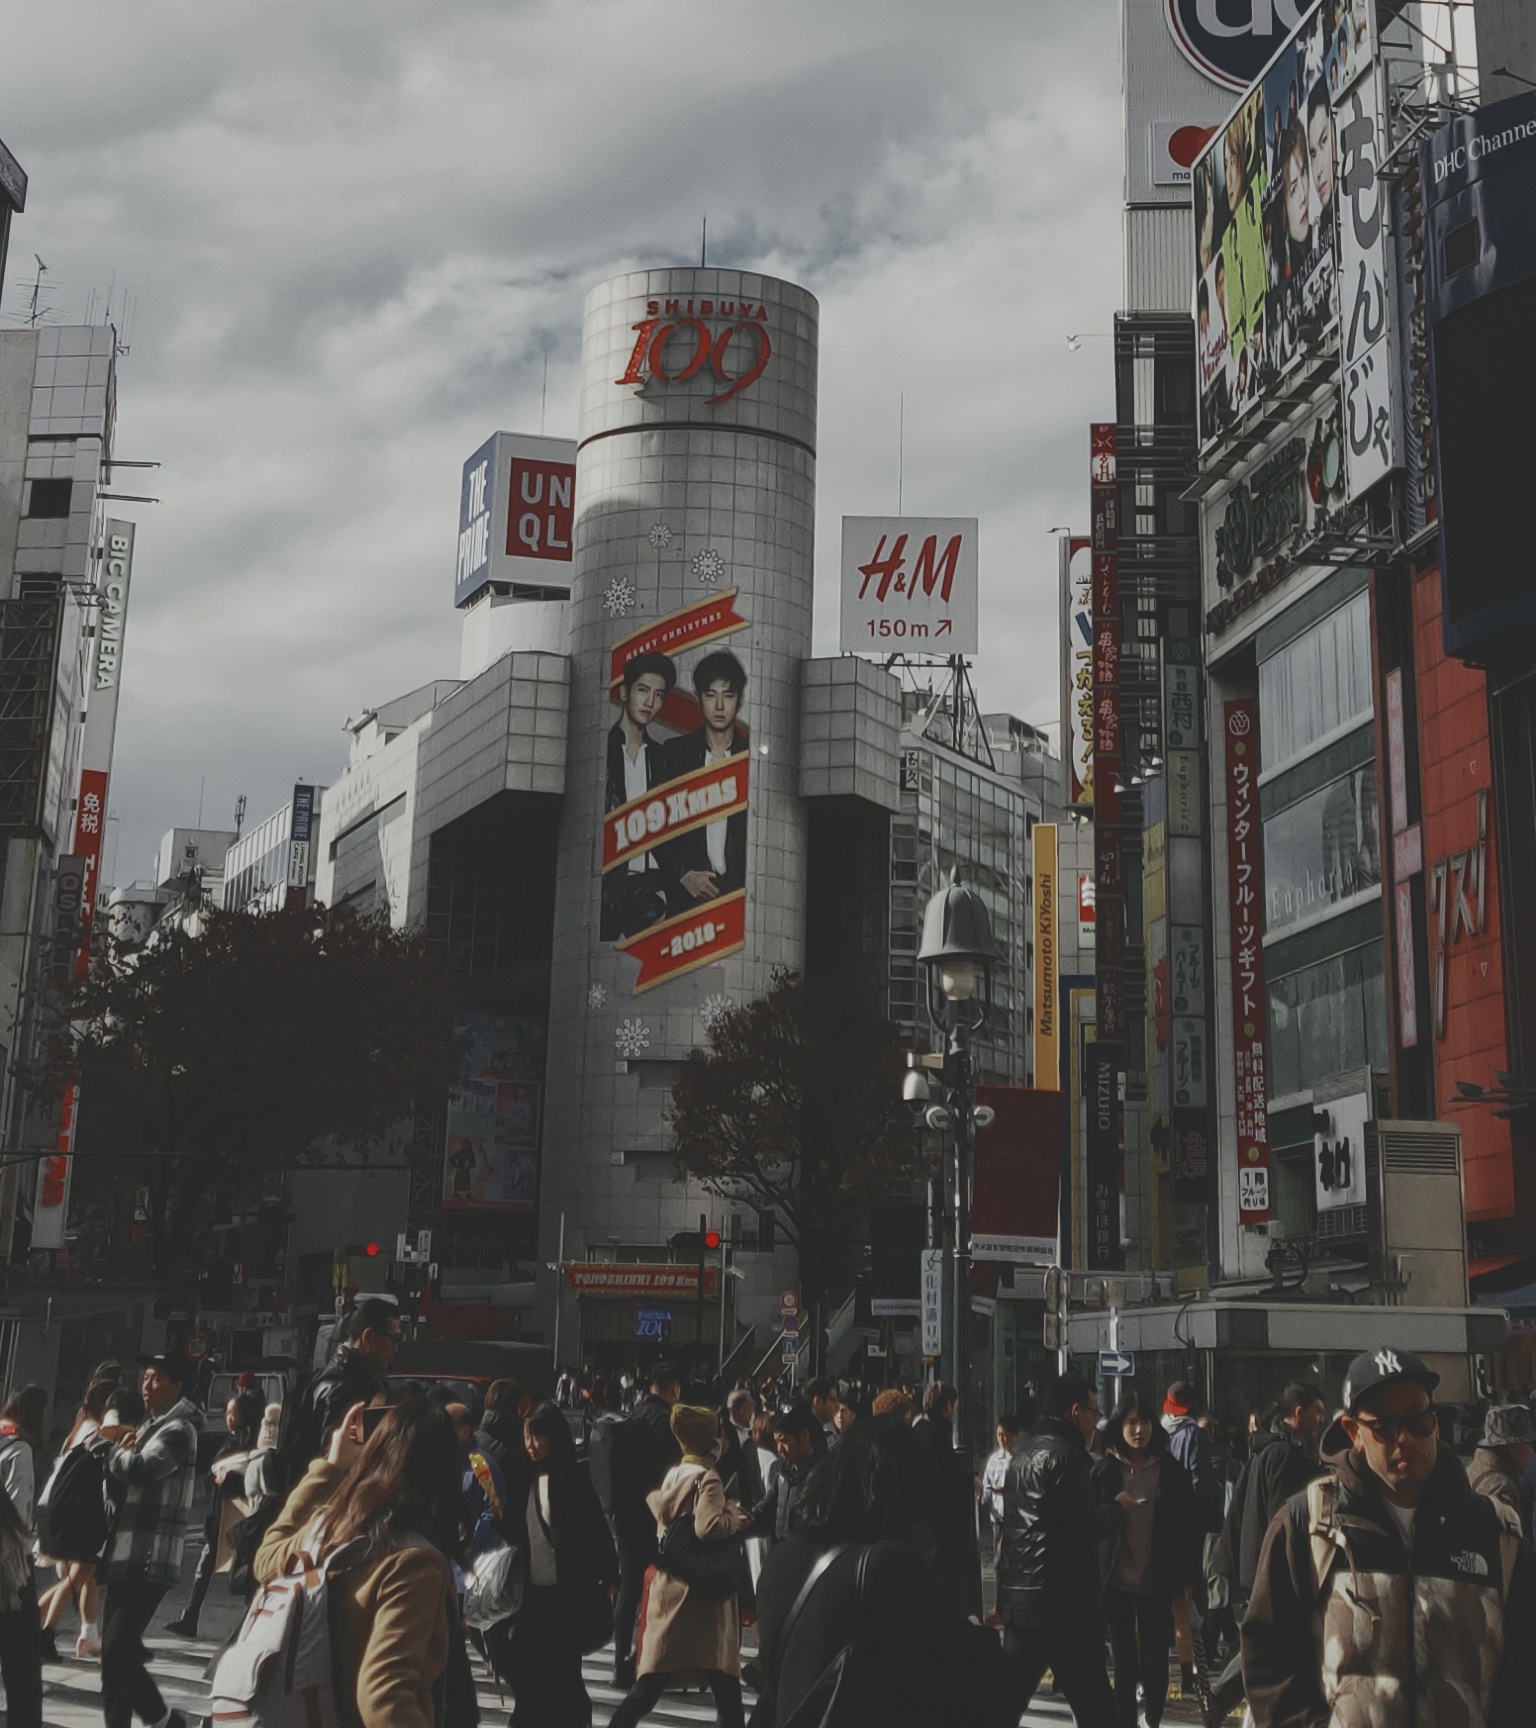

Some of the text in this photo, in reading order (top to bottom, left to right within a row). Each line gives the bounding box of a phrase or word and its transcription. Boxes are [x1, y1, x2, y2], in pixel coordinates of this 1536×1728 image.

[1433, 146, 1466, 183] DHC
[646, 299, 769, 322] SHIBUYA
[1341, 91, 1391, 467] もんじゃ
[615, 317, 772, 406] 109
[468, 458, 489, 522] THE
[457, 509, 491, 588] PRIME
[517, 513, 571, 549] QL
[857, 533, 963, 604] H&M
[96, 533, 129, 691] BIC CAMERA
[661, 611, 724, 644] CHRISTMAS
[80, 791, 101, 834] 免税
[1231, 762, 1258, 1017] ウィンターフルーツギフト
[1040, 936, 1053, 1037] Matsumoto
[1097, 1062, 1111, 1131] MIZUHO
[1095, 1184, 1110, 1261] みずほ銀行
